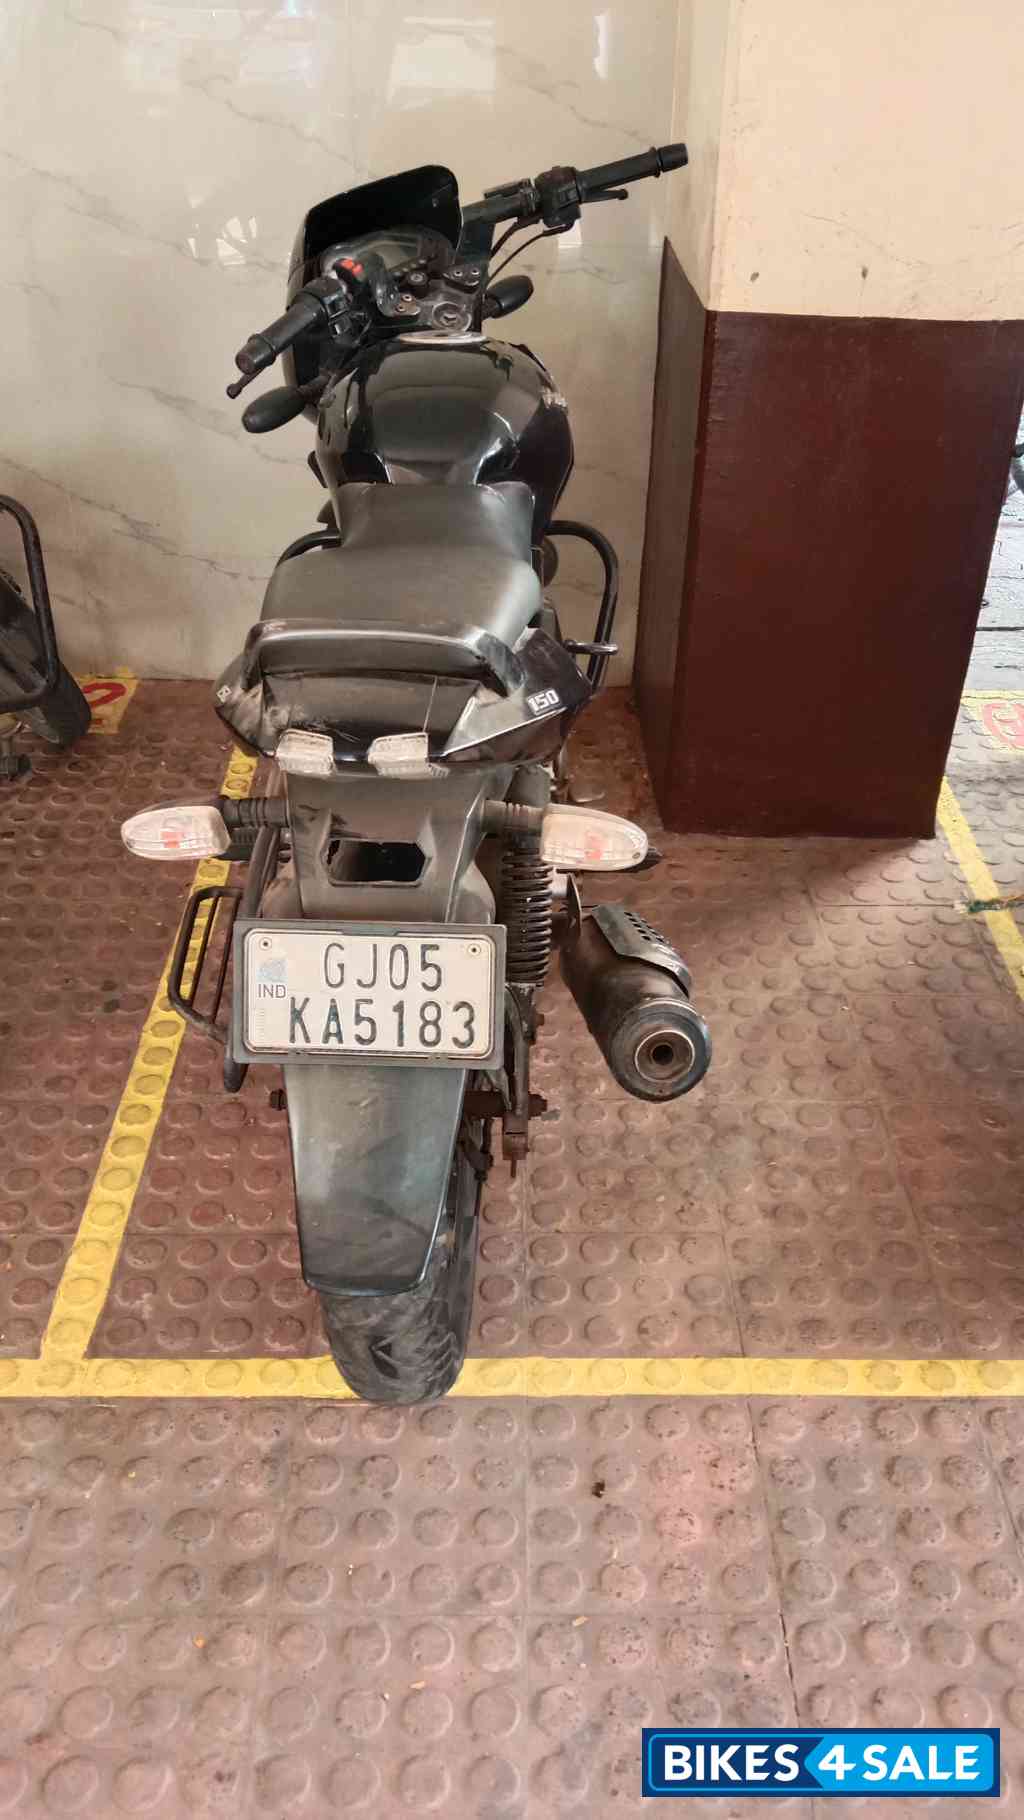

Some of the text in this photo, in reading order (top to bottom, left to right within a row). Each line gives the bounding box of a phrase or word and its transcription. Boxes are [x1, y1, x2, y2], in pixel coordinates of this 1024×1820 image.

[528, 689, 559, 711] 150
[323, 942, 442, 992] GJ05
[258, 984, 286, 999] IND
[289, 996, 475, 1049] KA5183
